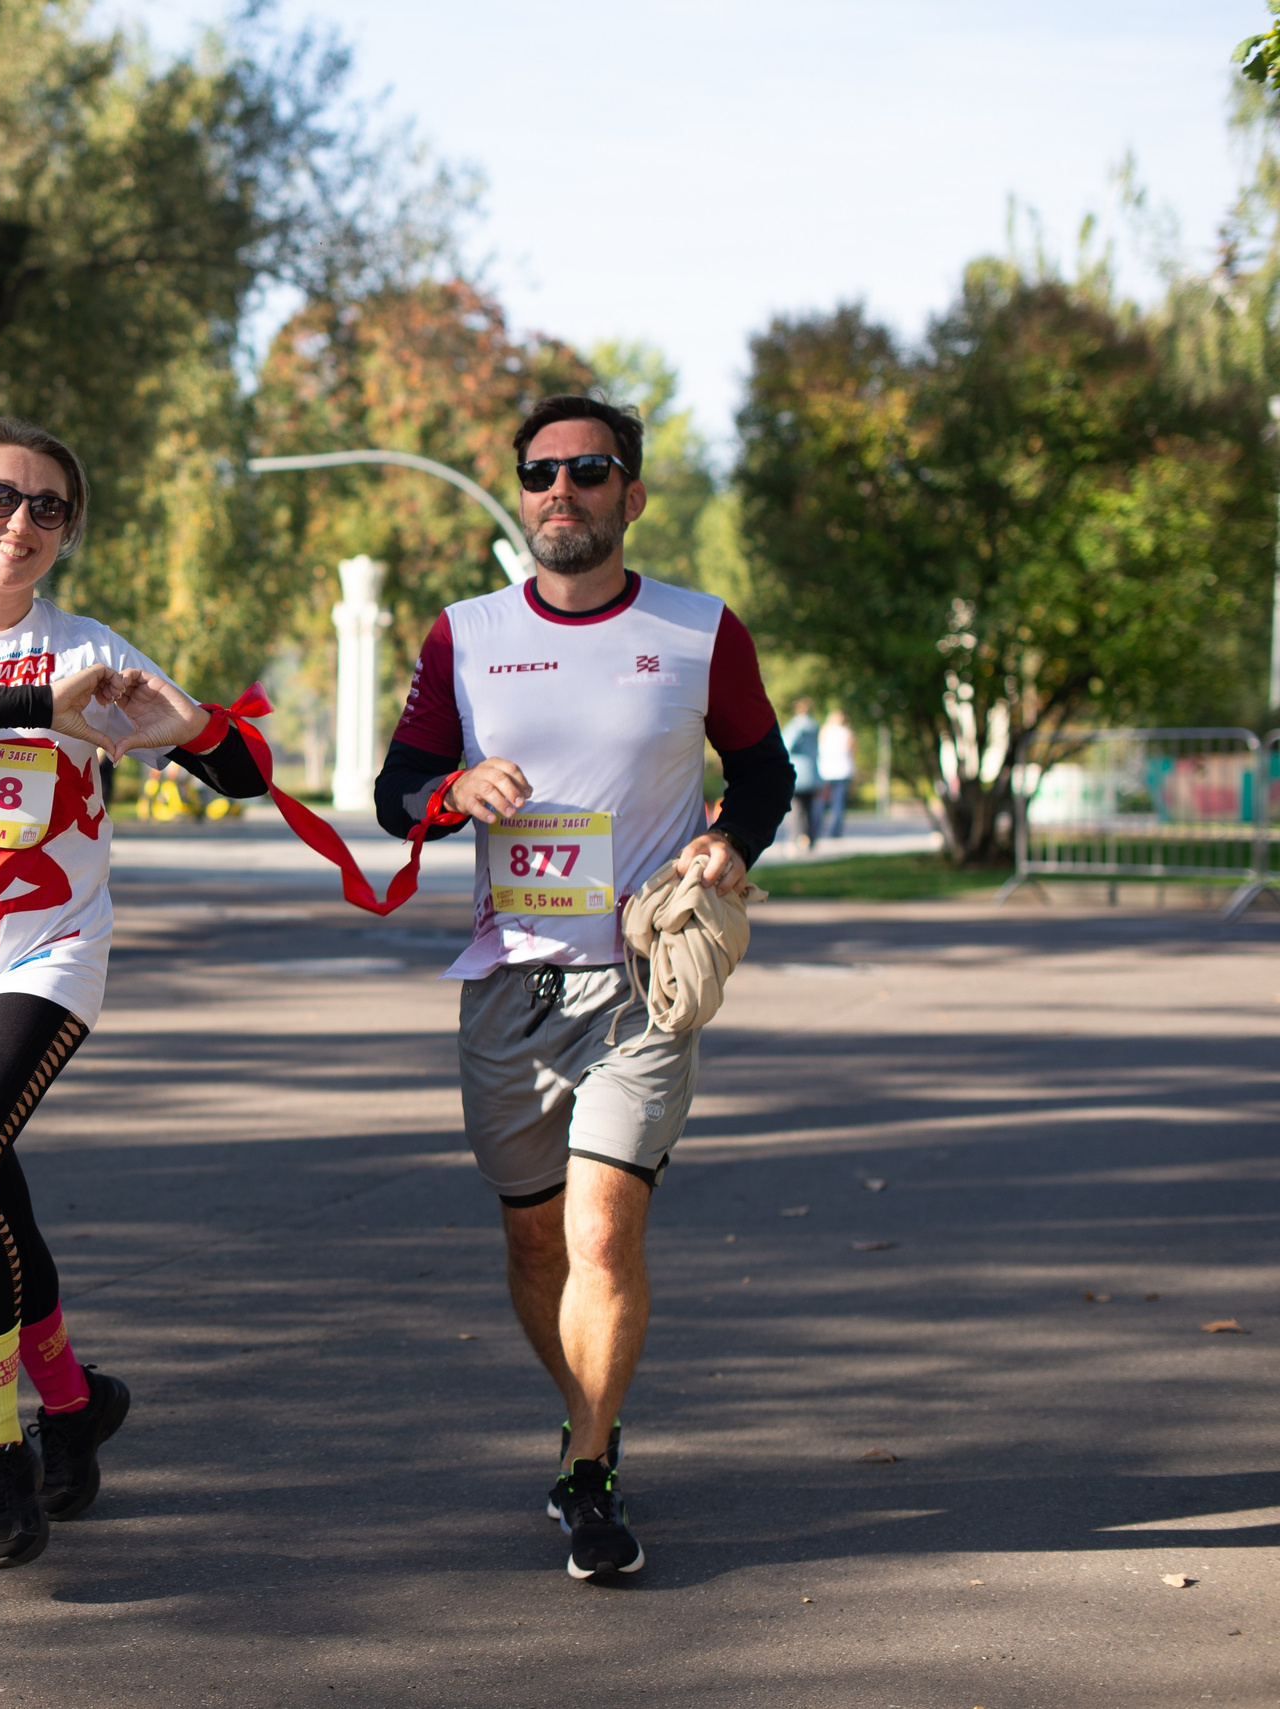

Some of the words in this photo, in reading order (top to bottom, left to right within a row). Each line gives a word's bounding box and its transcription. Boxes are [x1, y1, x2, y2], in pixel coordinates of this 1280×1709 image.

[489, 661, 558, 674] UTECH
[7, 750, 38, 762] ЗАБЕГ
[500, 817, 558, 829] ИНКЛЮЗИВНЫЙ
[562, 817, 591, 828] ЗАБЕГ
[510, 844, 580, 877] 877
[524, 893, 547, 910] 5,5
